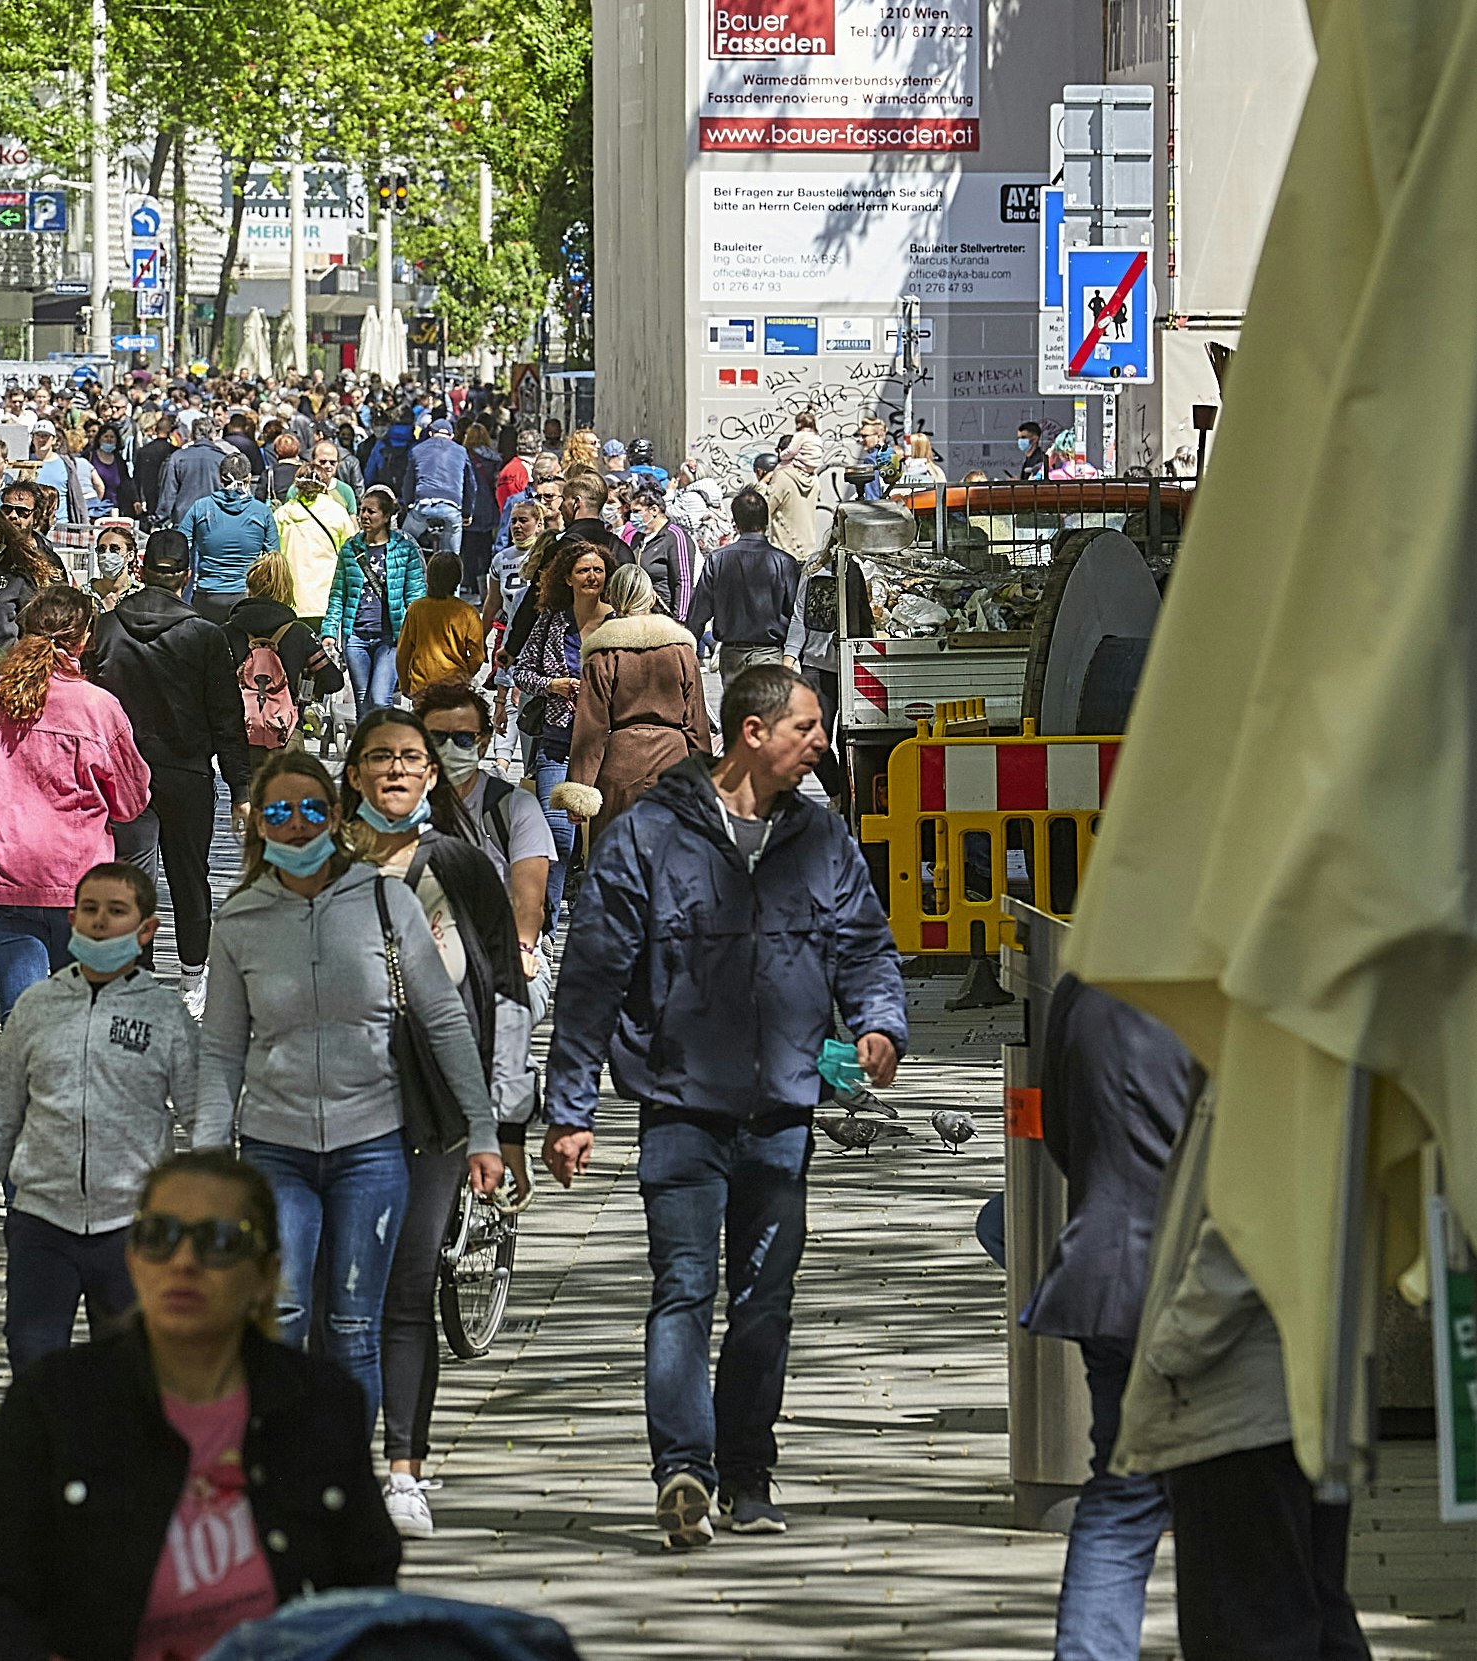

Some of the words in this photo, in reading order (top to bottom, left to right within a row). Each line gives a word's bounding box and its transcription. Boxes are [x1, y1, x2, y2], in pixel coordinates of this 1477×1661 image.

[880, 8, 910, 19] 1210
[915, 7, 949, 19] Wien
[717, 10, 788, 32] Bauer
[850, 26, 877, 37] Tel.:
[881, 26, 896, 37] 01
[912, 26, 936, 37] 817
[717, 33, 826, 54] Fassaden
[742, 74, 942, 89] Wärmedämmverbundsysteme
[708, 92, 848, 106] Fassadenrenovierung
[862, 92, 973, 106] Wärmedämmung
[707, 124, 973, 145] www.bauer-fassaden.at
[713, 187, 731, 198] Bei
[735, 187, 774, 200] Fragen
[776, 190, 794, 198] zur
[797, 188, 849, 198] Baustelle
[852, 188, 895, 198] wenden
[899, 188, 917, 198] Sie
[919, 188, 943, 198] sich
[713, 202, 739, 211] bitte
[759, 203, 790, 212] Herrn
[793, 203, 825, 212] Celen
[828, 203, 854, 212] oder
[857, 203, 888, 212] Herrn
[892, 203, 942, 212] Kuranda:
[1006, 209, 1026, 220] Bau
[713, 243, 763, 252] Bauleiter
[909, 243, 957, 253] Bauleiter
[960, 243, 1026, 253] Stellvertreter:
[909, 255, 948, 265] Marcus
[951, 255, 989, 265] Kuranda
[713, 268, 826, 280] office@ayka-bau.com
[909, 269, 1011, 281] office@ayka-bau.com
[713, 282, 727, 292] 01
[729, 282, 750, 292] 276
[752, 282, 766, 292] 47
[767, 282, 781, 292] 93
[909, 283, 923, 293] 01
[925, 283, 945, 293] 276
[948, 283, 960, 293] 47
[961, 283, 974, 293] 93
[952, 370, 975, 382] KEIN
[979, 368, 1023, 382] MENSCH
[954, 386, 972, 396] IST
[978, 383, 1027, 395] ILLEGAL
[112, 1016, 152, 1036] SKATE
[110, 1027, 151, 1047] RULES
